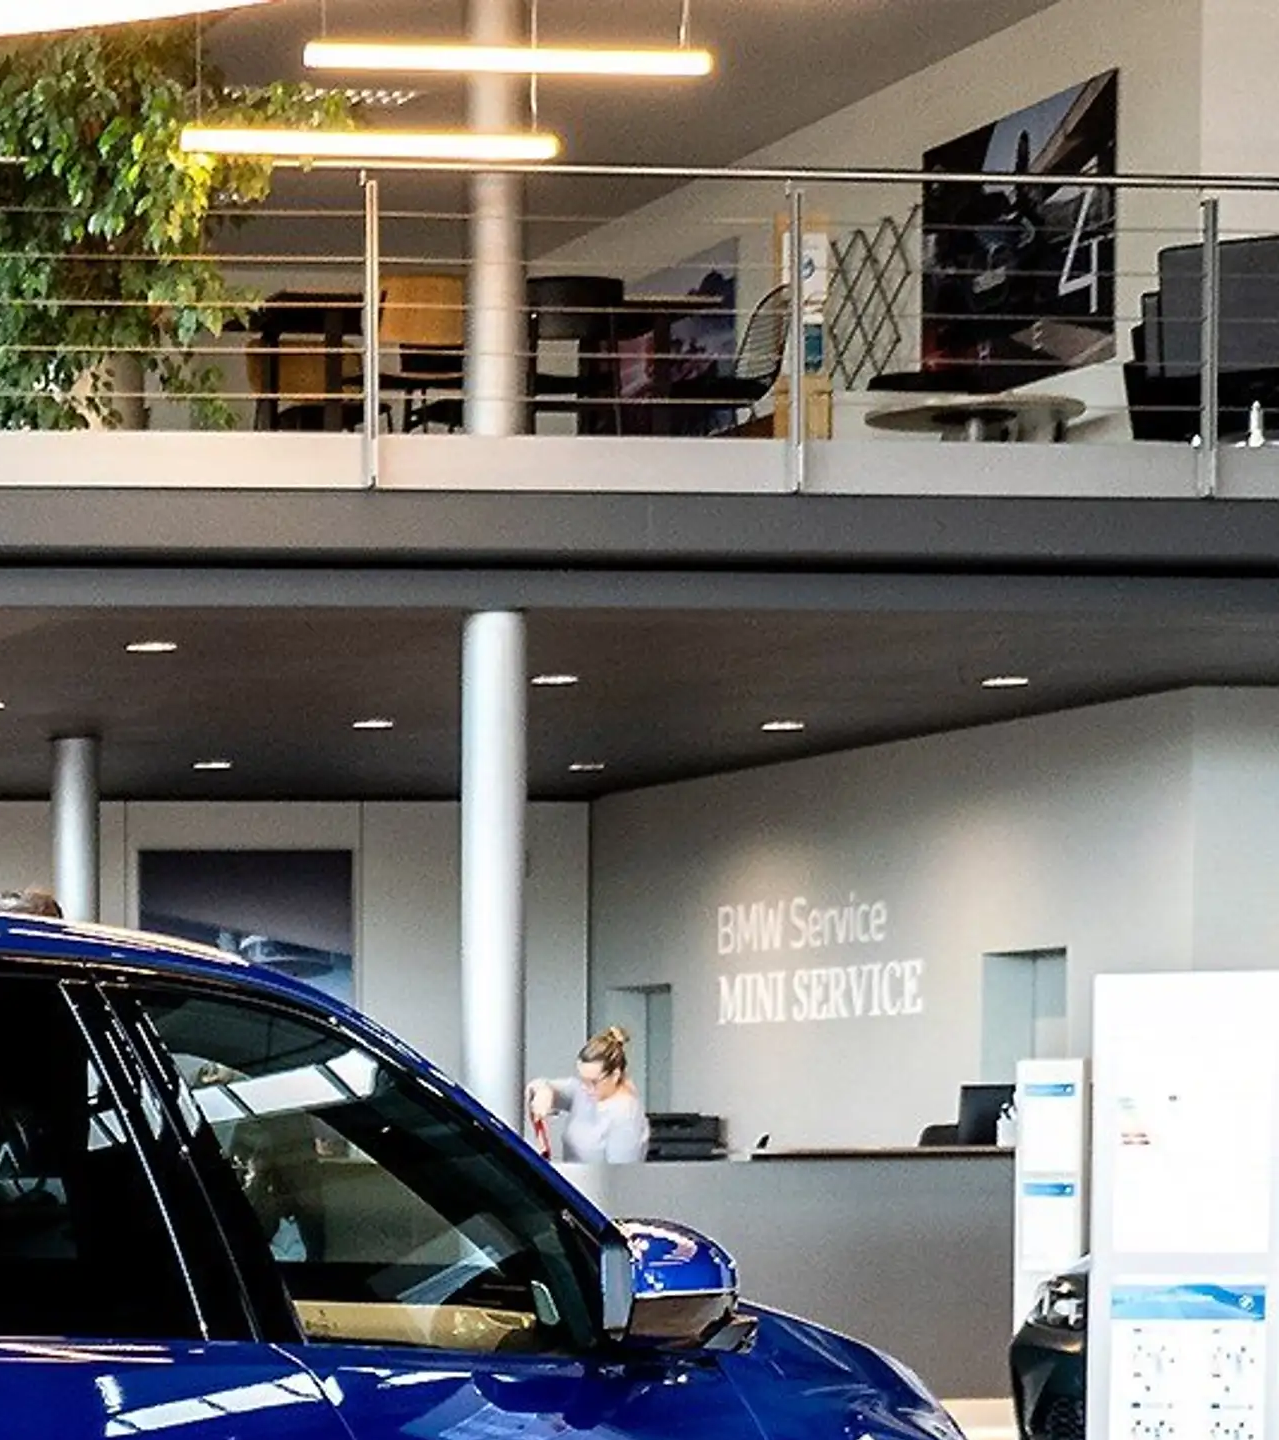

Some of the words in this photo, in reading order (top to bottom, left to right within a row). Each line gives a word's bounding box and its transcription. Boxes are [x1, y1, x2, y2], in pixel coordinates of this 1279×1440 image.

[716, 897, 786, 956] BMW
[789, 891, 888, 949] Service
[716, 970, 786, 1025] MINI
[792, 957, 926, 1022] SERVICE
